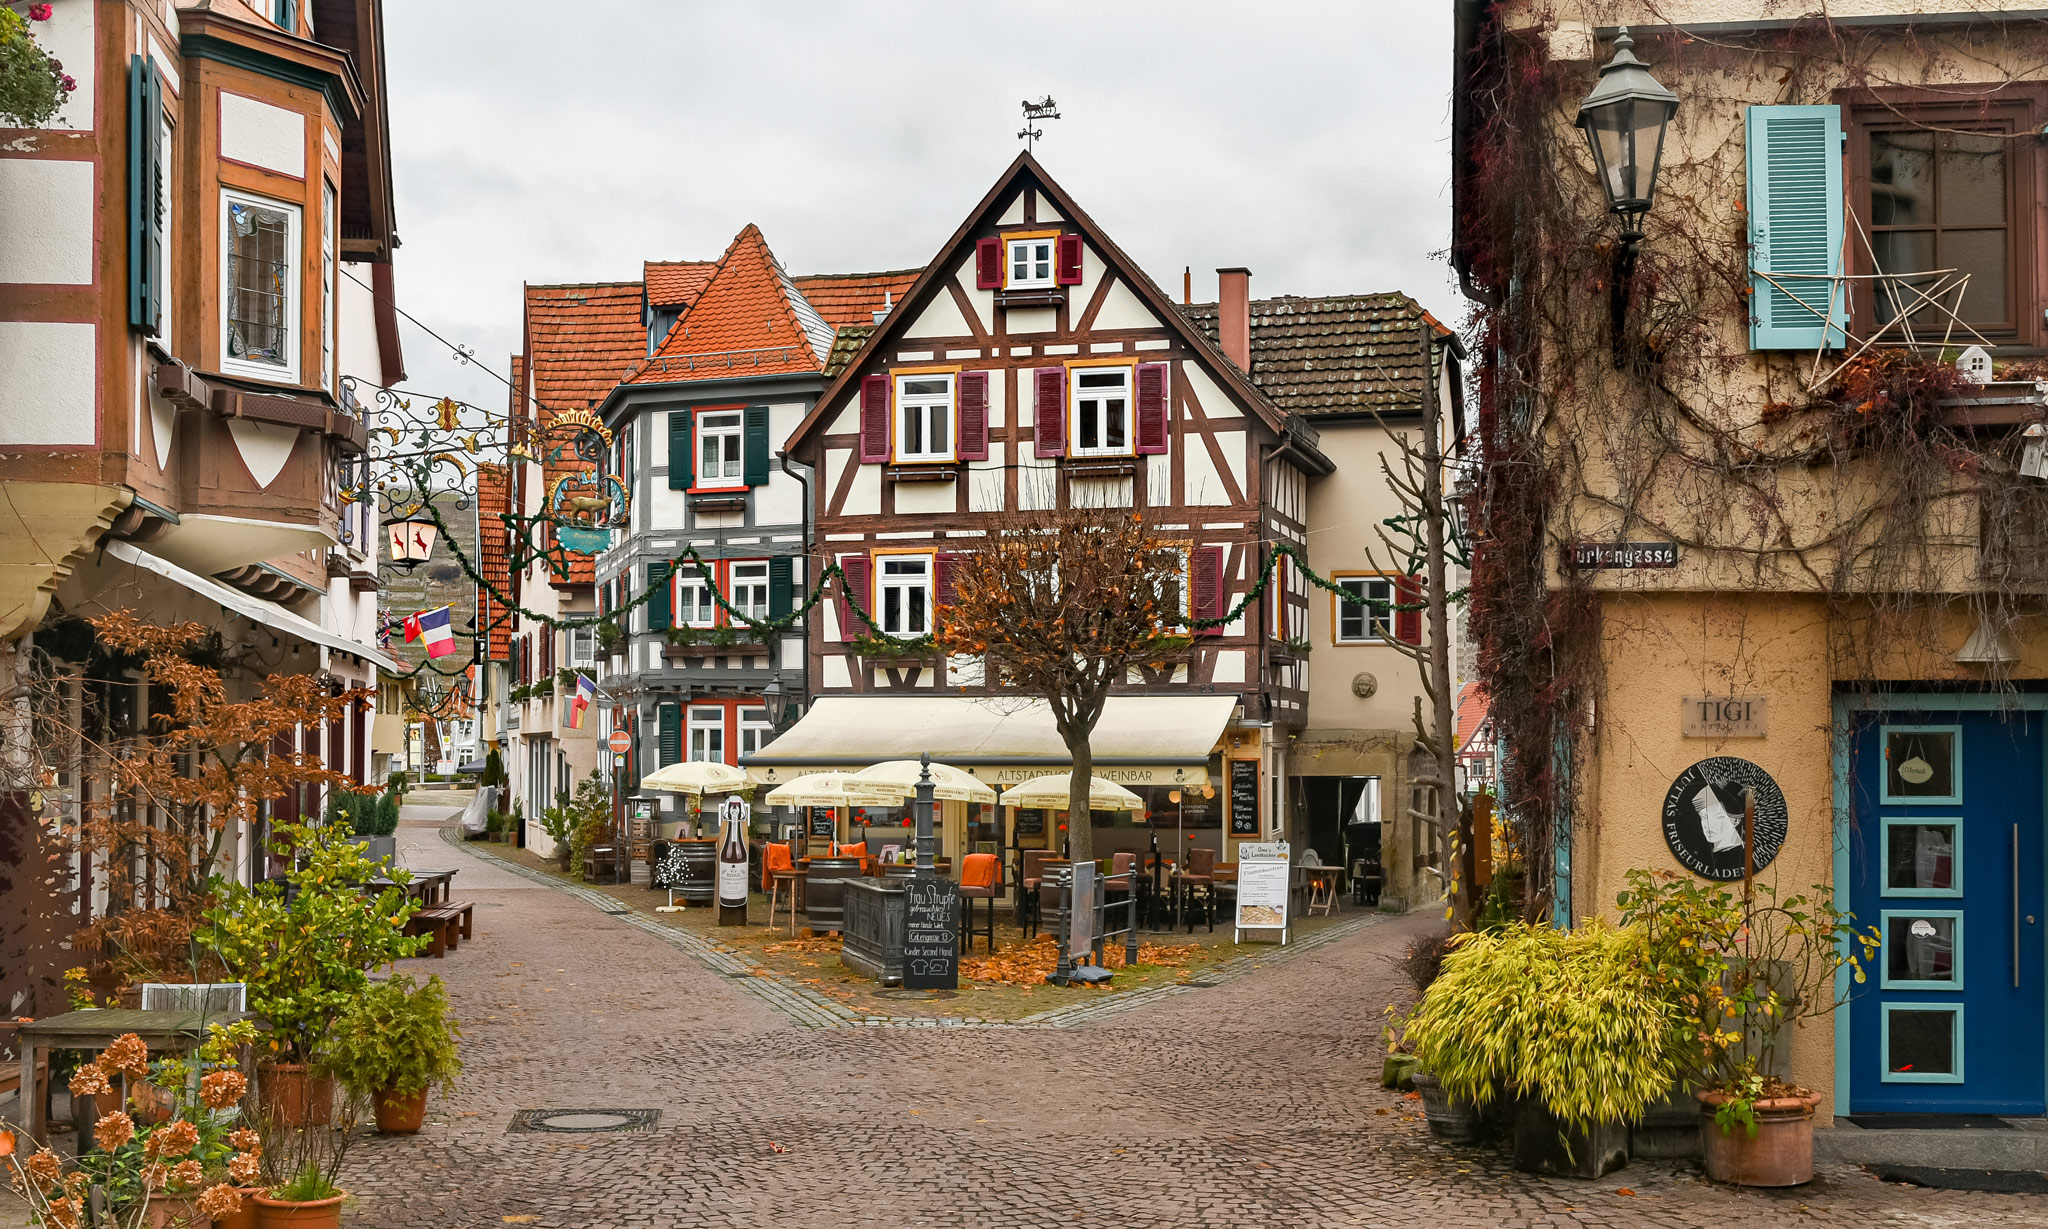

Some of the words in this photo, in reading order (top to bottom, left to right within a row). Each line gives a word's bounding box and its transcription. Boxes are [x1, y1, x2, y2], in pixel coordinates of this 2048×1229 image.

[1566, 545, 1673, 568] ürkengasse
[1696, 701, 1753, 722] TIGI
[1099, 770, 1152, 781] WEINBAR
[905, 884, 926, 904] Frau
[926, 884, 956, 910] Strupfe
[926, 912, 951, 922] NEUES
[940, 932, 948, 941] 13
[904, 946, 921, 956] Kinder
[921, 945, 938, 957] Second
[938, 946, 953, 957] Hand
